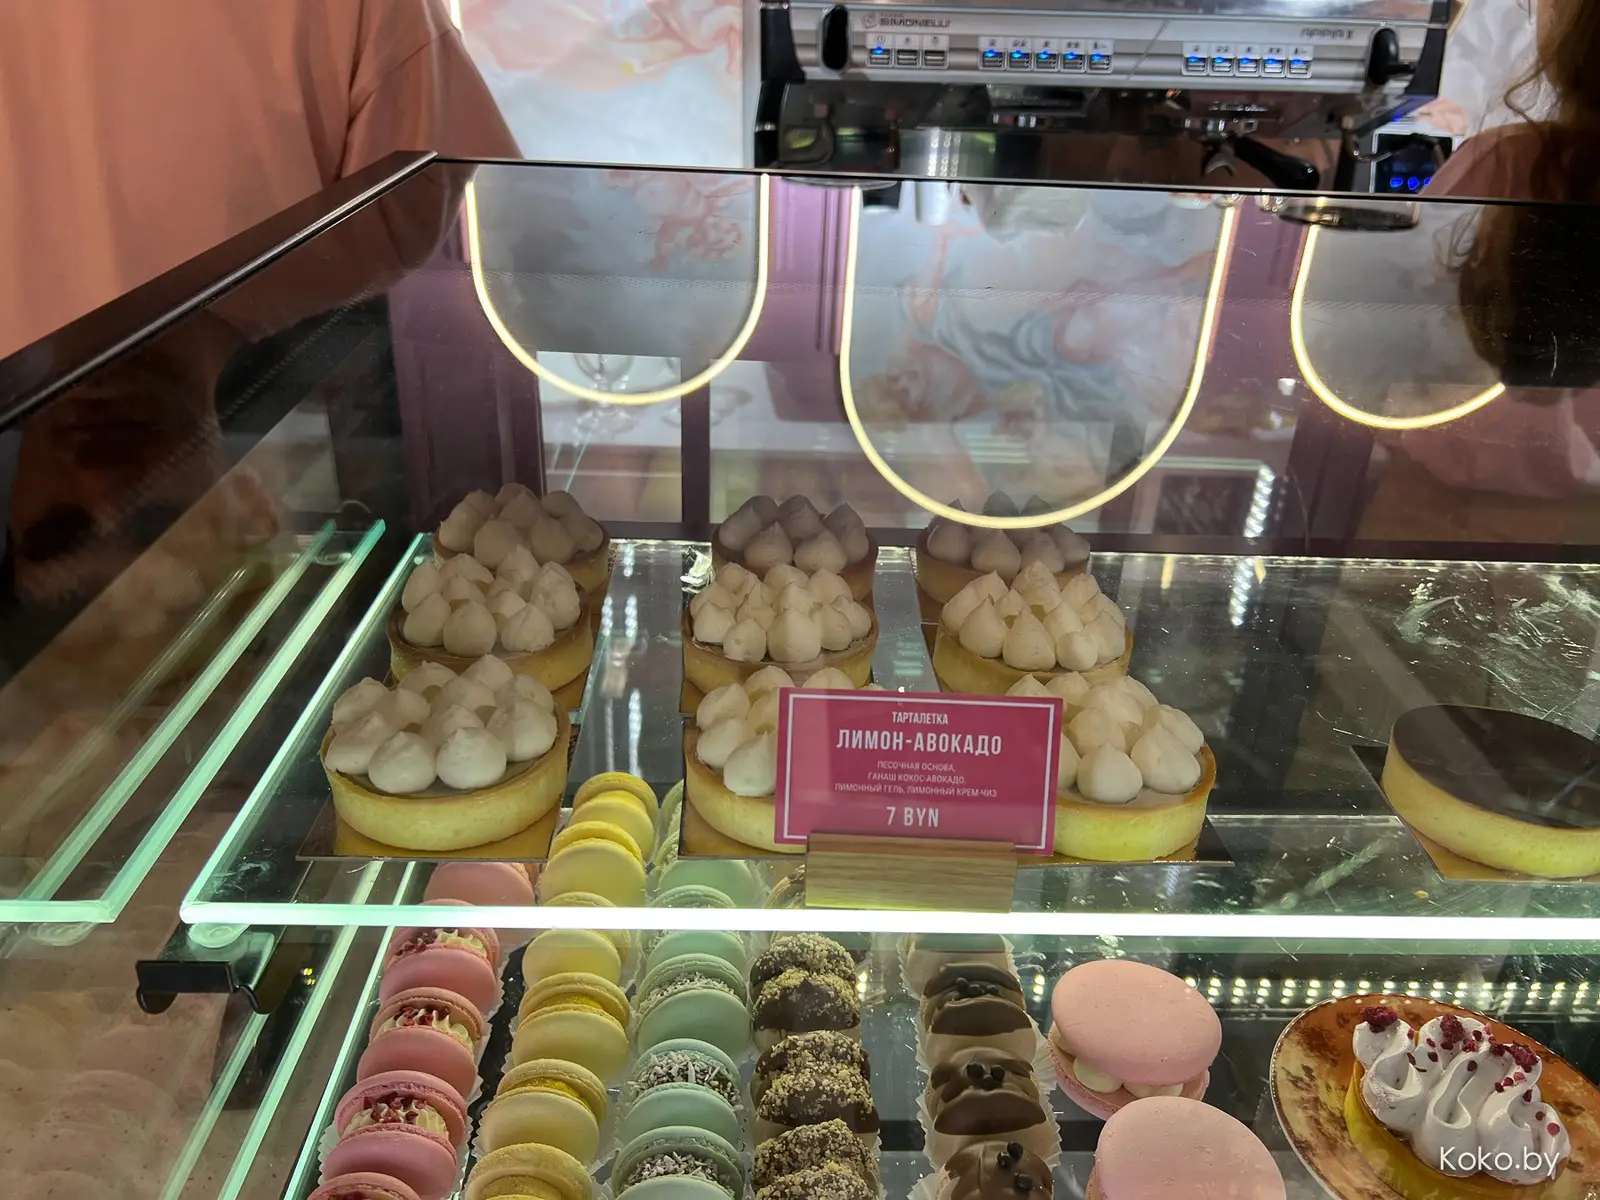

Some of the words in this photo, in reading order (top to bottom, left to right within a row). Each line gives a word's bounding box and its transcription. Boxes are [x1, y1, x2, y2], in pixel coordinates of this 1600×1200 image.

[892, 711, 949, 725] ТАРТАЛЕТКА
[836, 729, 1003, 756] ЛИМОН-АВОКАДО
[877, 761, 920, 771] ПЕСОЧНАЯ
[921, 762, 956, 773] ОСНОВА,
[868, 772, 896, 782] ГАНАШ
[834, 782, 882, 793] ЛИМОННЫЙ
[883, 784, 906, 794] ГЕЛЬ,
[907, 785, 955, 796] ЛИМОННЫЙ
[956, 787, 998, 798] КРЕМ-ЧИЗ
[886, 806, 897, 825] 7
[903, 807, 939, 828] BYN
